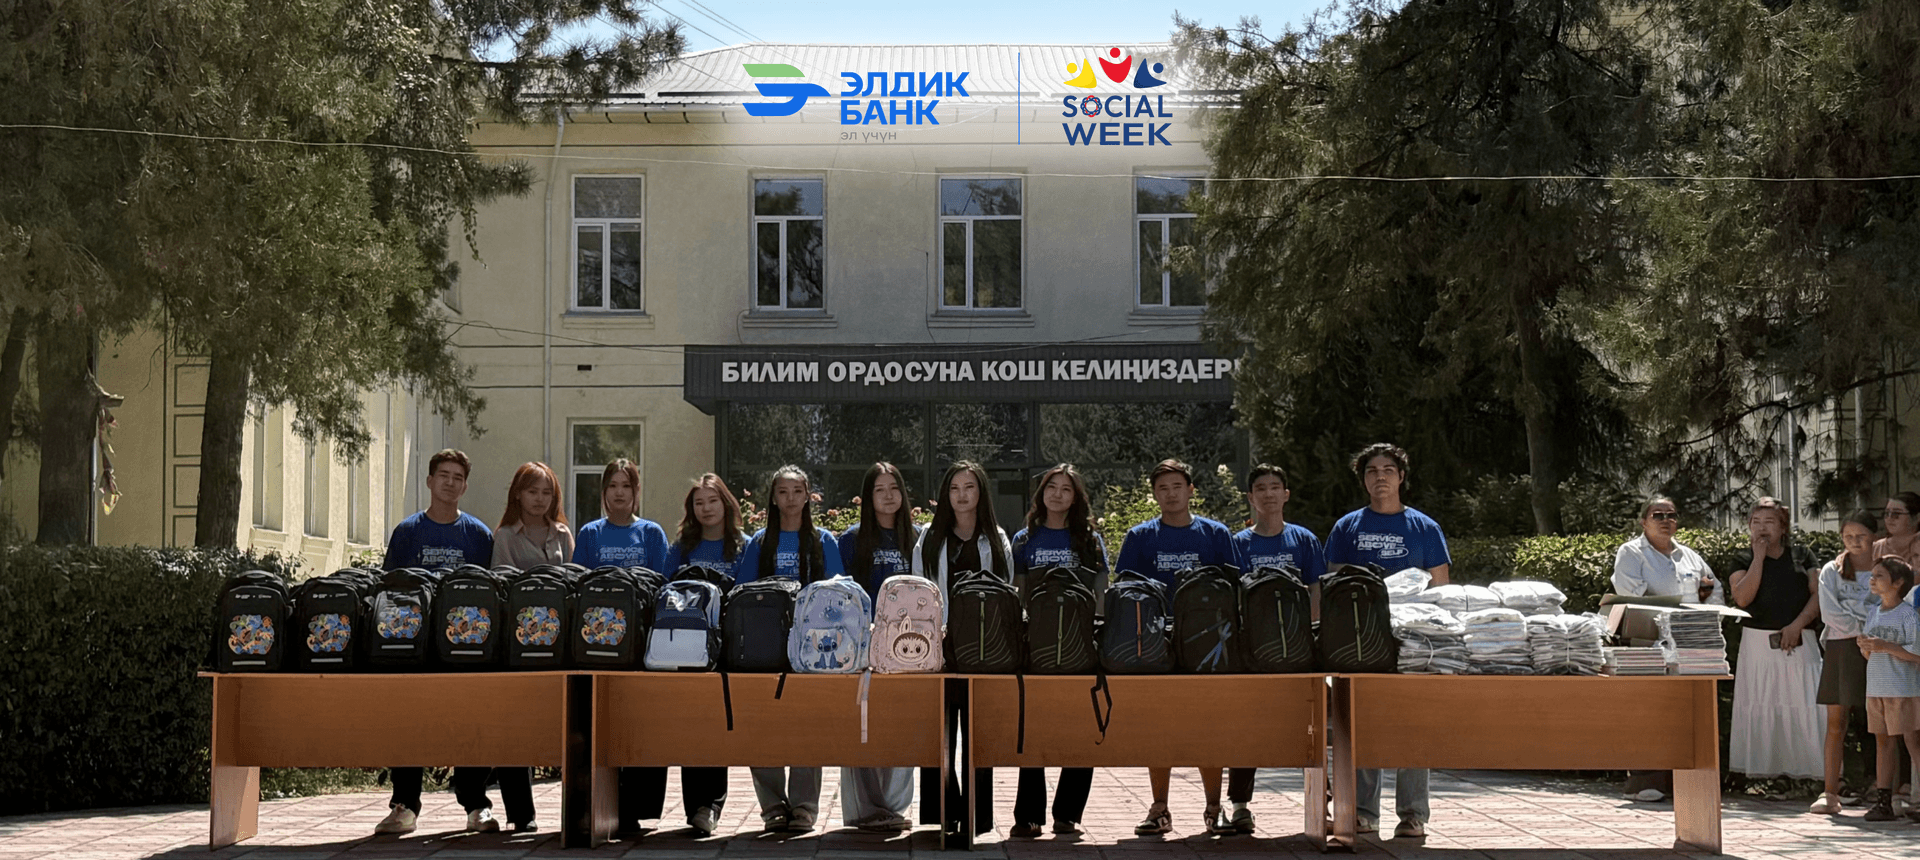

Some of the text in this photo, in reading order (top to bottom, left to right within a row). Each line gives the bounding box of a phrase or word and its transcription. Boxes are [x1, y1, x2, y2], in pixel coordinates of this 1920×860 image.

[721, 361, 820, 383] БИЛИМ
[827, 361, 976, 386] ОРДОСУНА
[981, 360, 1046, 381] КОШ
[1358, 534, 1404, 543] SERVICE
[1357, 541, 1397, 549] ABOVE
[422, 548, 464, 557] SERVICE
[1157, 553, 1199, 561] SERVICE
[1251, 554, 1293, 564] SERVICE
